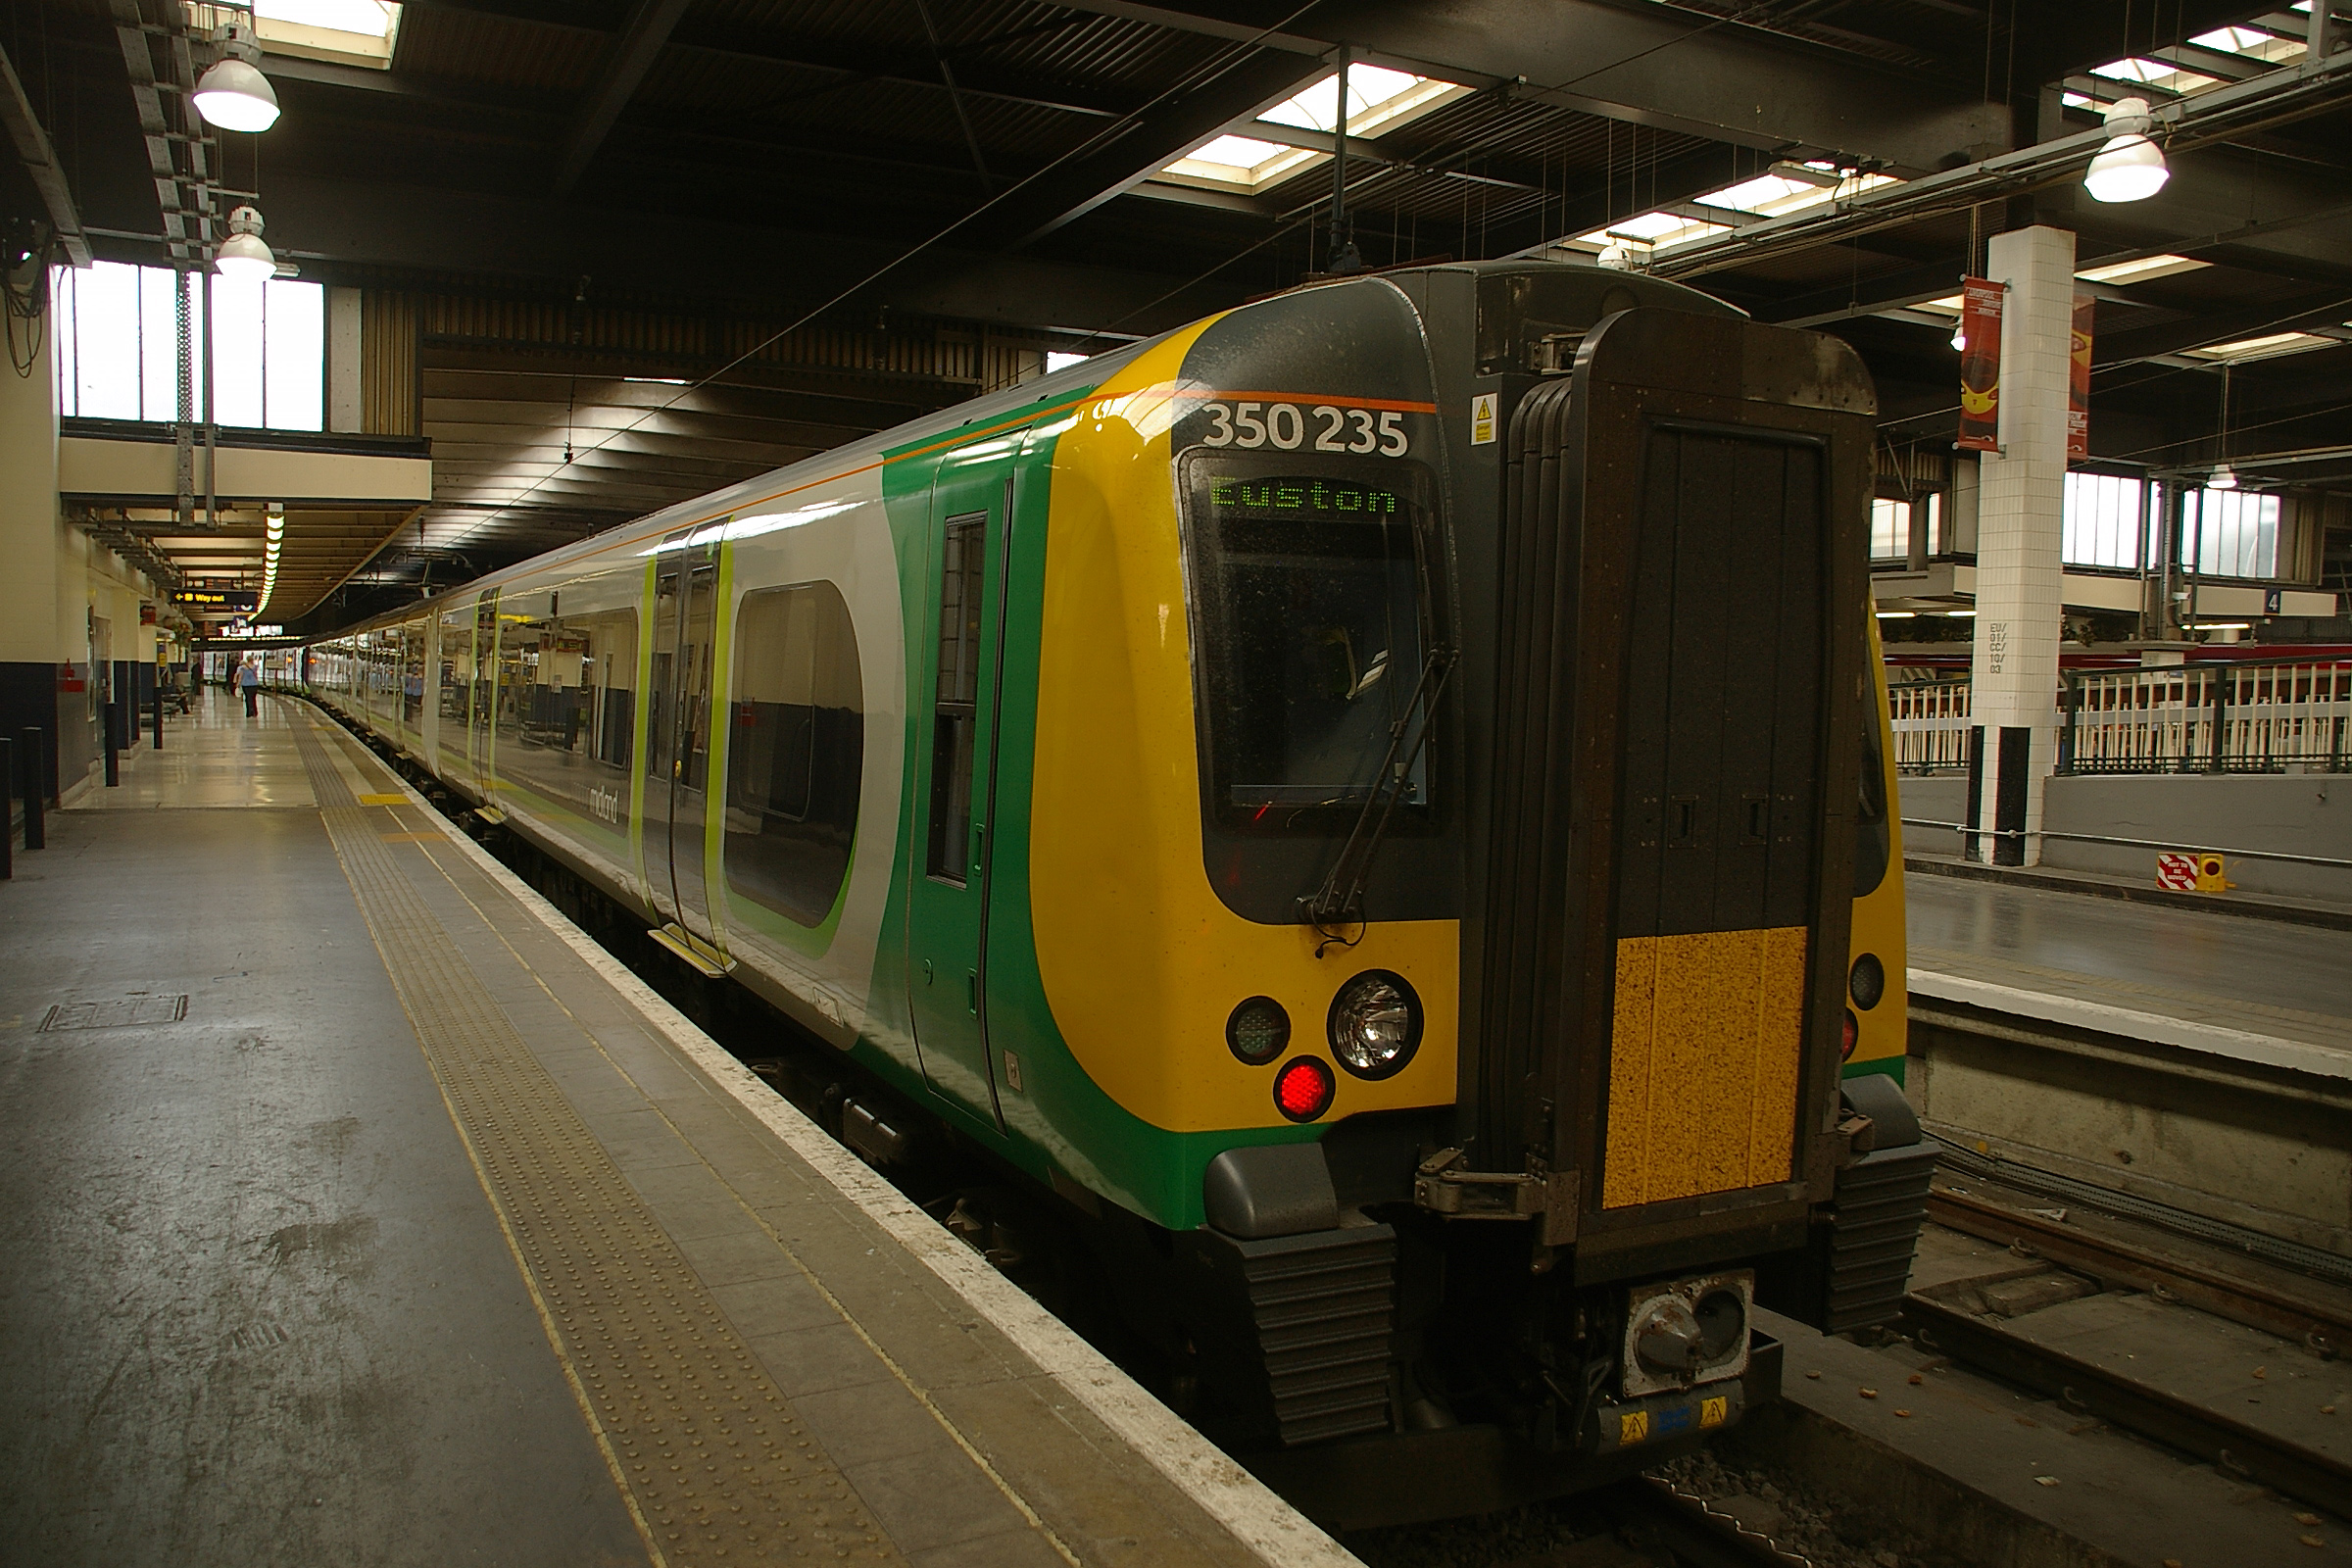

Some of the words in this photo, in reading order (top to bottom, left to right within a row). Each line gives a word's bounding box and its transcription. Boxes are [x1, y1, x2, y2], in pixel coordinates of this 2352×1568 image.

[1201, 403, 1304, 451] 350
[1311, 406, 1408, 458] 235
[1211, 476, 1396, 514] Euston
[195, 593, 212, 603] Way
[2268, 593, 2278, 611] 4
[1989, 622, 2007, 632] EU/
[1989, 643, 2007, 652] CC/
